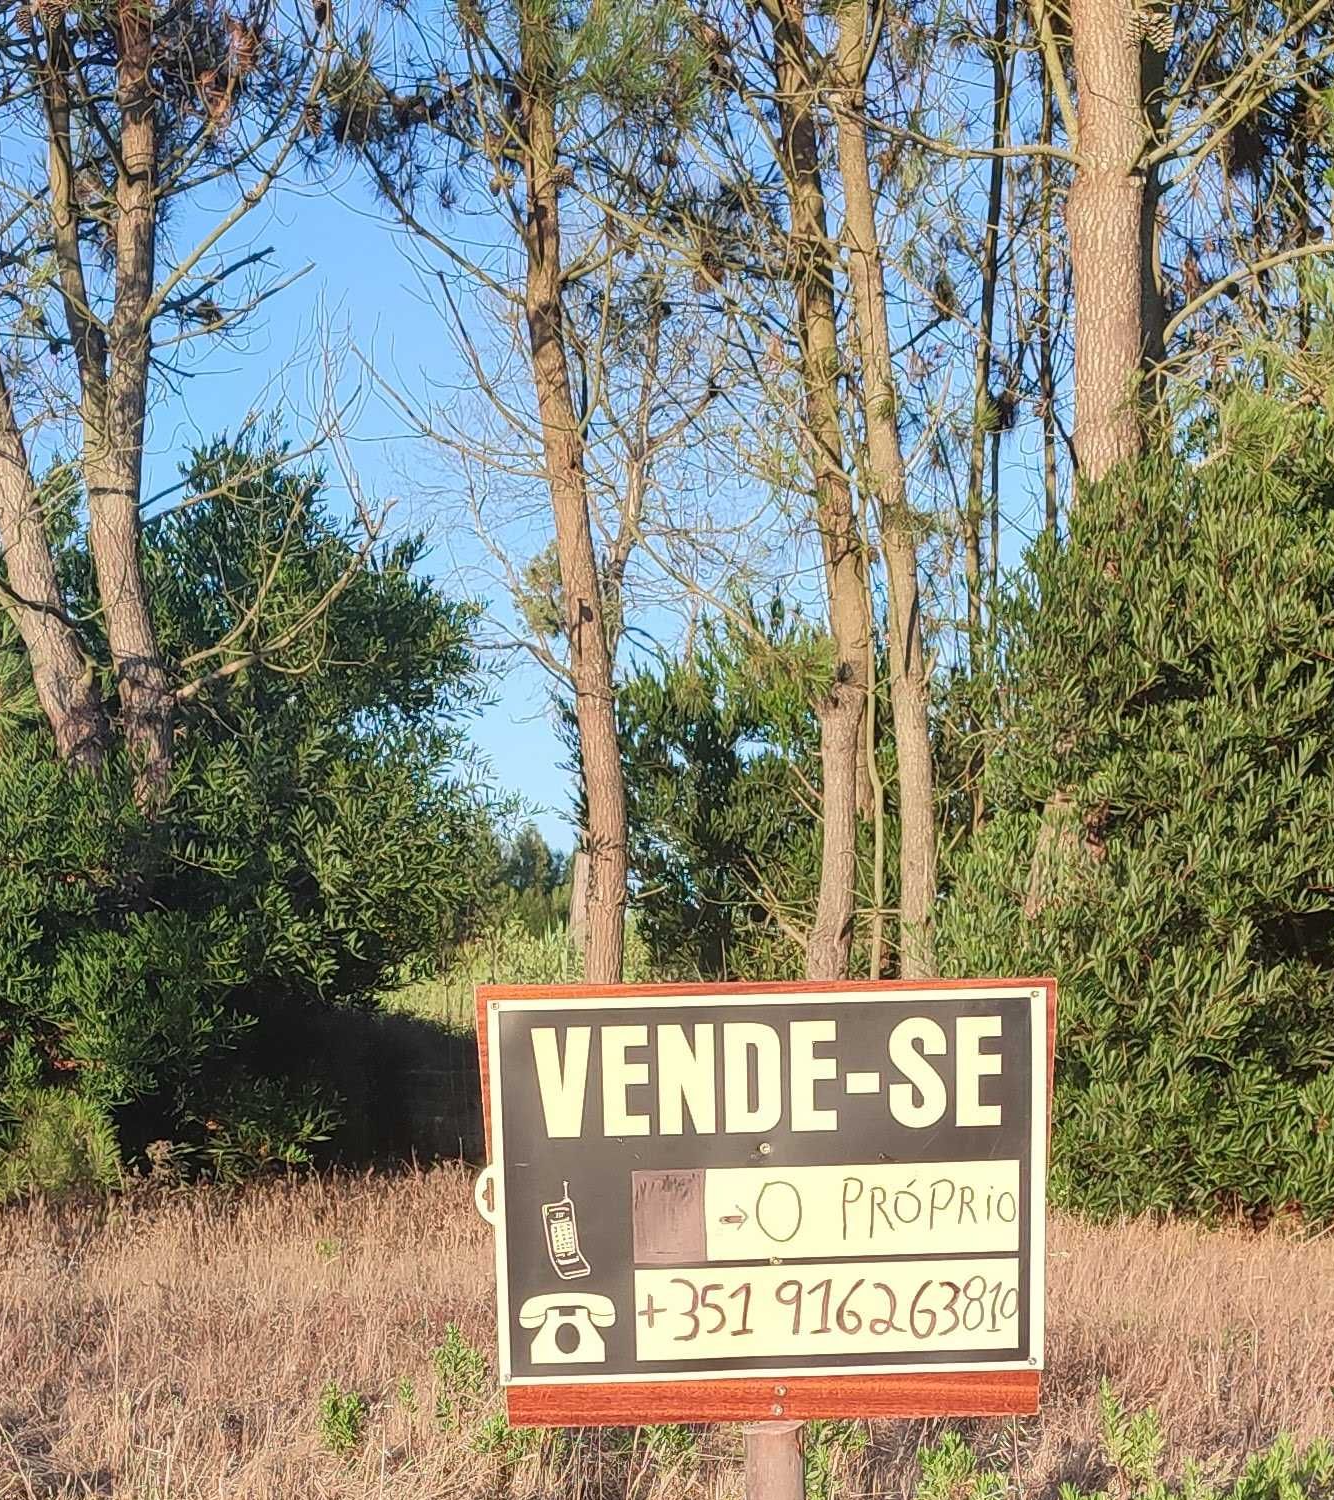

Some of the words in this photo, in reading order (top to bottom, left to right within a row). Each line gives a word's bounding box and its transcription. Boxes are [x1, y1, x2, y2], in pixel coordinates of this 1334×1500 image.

[531, 1016, 1003, 1139] VENDE-SE
[755, 1181, 802, 1242] O
[638, 1278, 754, 1341] +351
[775, 1275, 1018, 1339] 916263810
